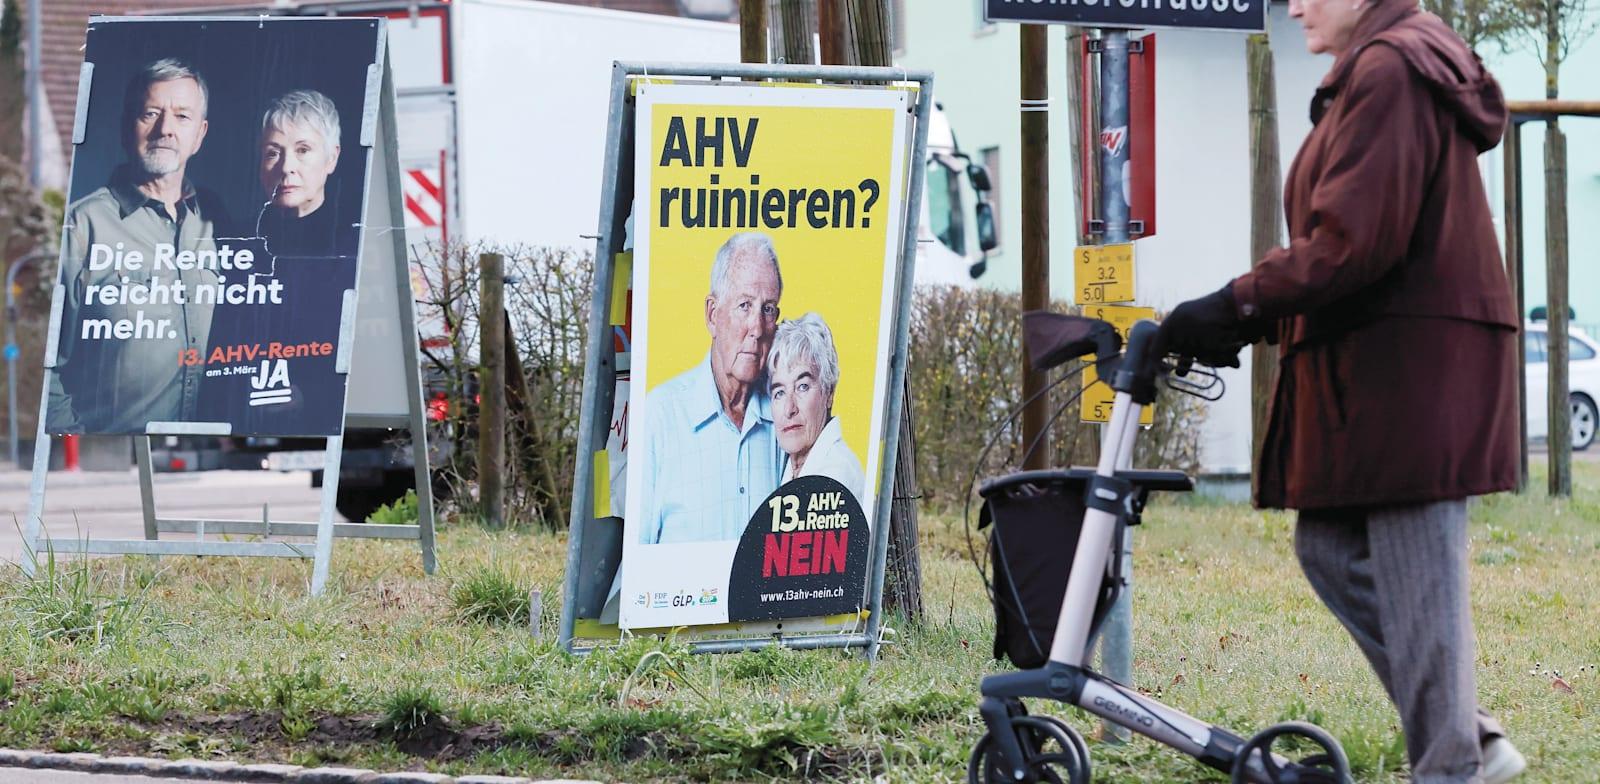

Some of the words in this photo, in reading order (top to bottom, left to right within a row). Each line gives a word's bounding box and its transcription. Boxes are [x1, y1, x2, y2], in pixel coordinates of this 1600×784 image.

[659, 116, 759, 168] AHV
[660, 174, 880, 229] ruinieren?
[89, 242, 143, 270] Die
[153, 243, 254, 270] Rente
[1082, 250, 1090, 264] S
[1097, 266, 1116, 280] 3.2
[85, 276, 186, 305] reicht
[195, 275, 283, 304] nicht
[81, 310, 177, 340] mehr.
[177, 348, 205, 368] 13.
[208, 341, 333, 364] AHV-Rente
[206, 368, 222, 377] am
[223, 366, 232, 376] 3.
[234, 364, 257, 375] März
[251, 359, 291, 390] JA
[769, 494, 805, 533] 13.
[807, 492, 845, 511] AHV-
[806, 511, 850, 531] Rente
[763, 530, 849, 578] NEIN
[761, 586, 844, 602] www.13ahv-nein.ch
